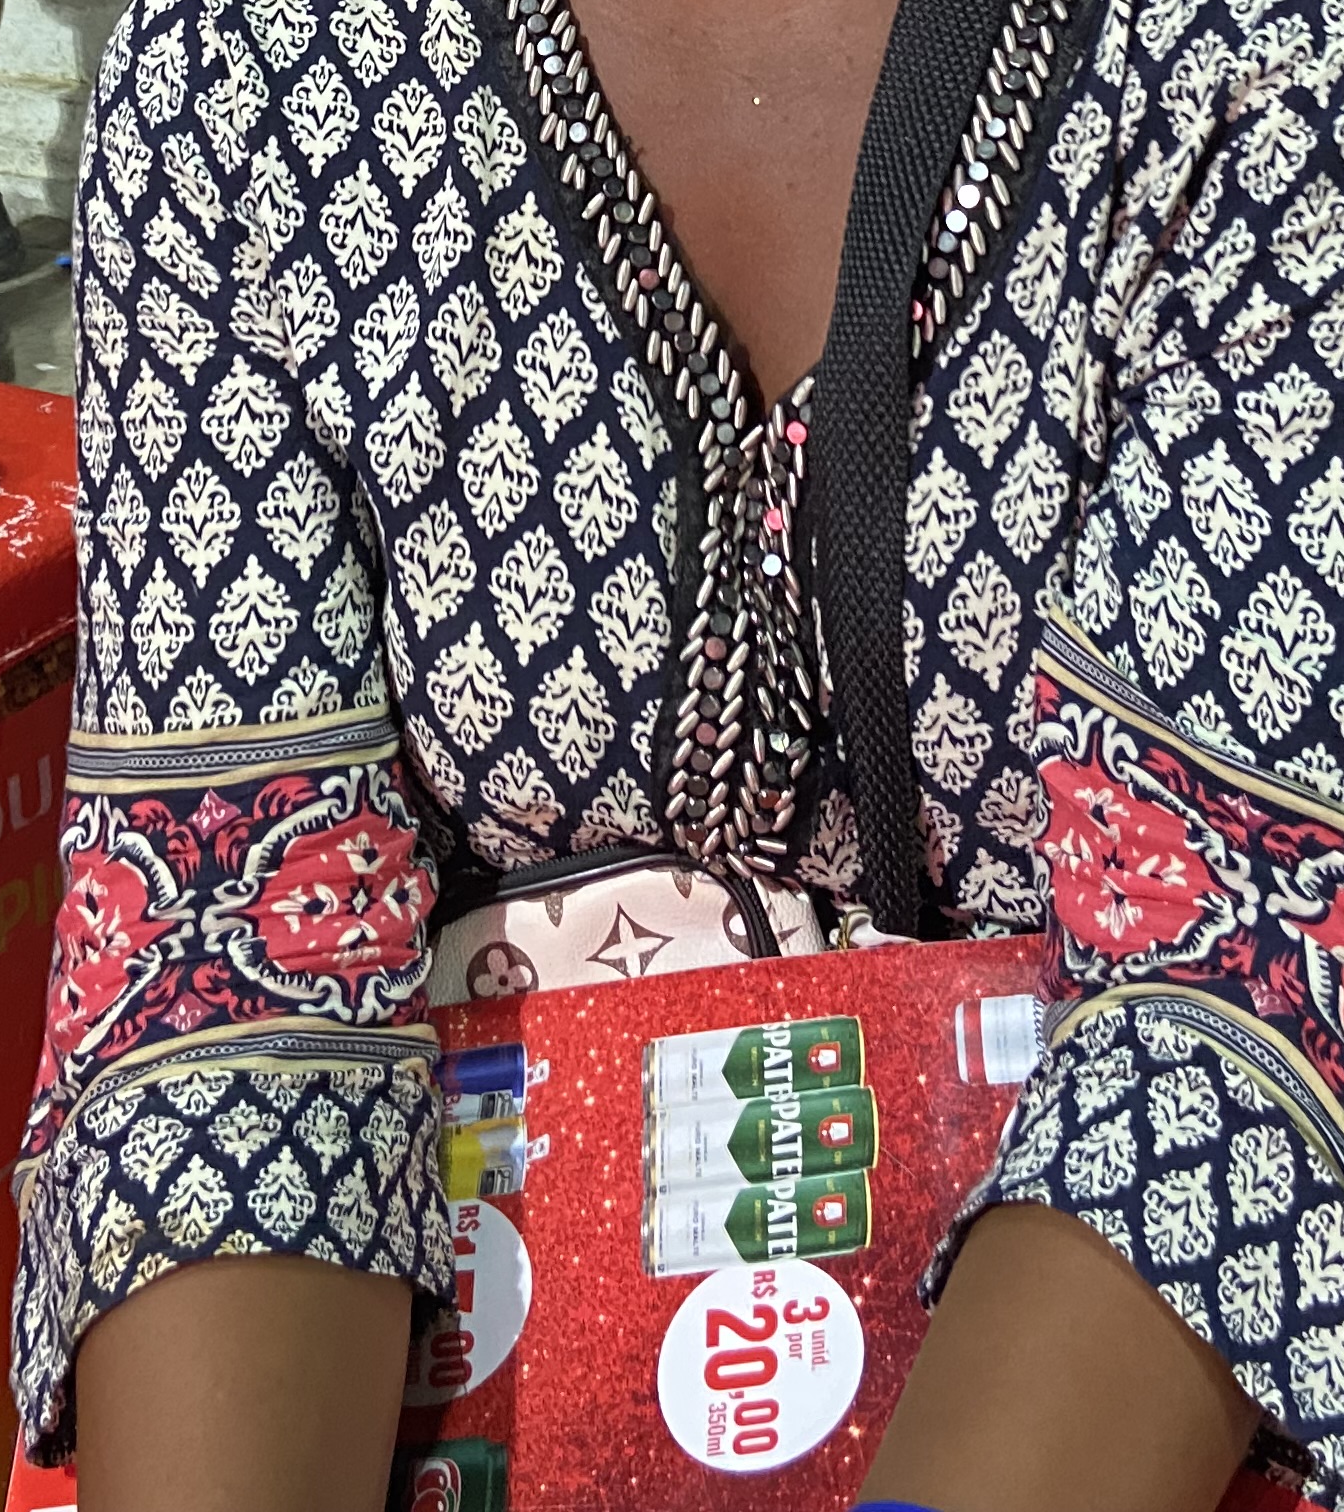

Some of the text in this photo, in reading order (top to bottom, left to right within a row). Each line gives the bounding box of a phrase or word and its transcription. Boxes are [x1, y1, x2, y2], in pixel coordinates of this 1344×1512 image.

[455, 1204, 482, 1234] R$
[782, 1295, 831, 1372] 3 unid.
[785, 1332, 804, 1361] por
[703, 1269, 780, 1456] R$ 20,00
[706, 1401, 726, 1458] 350ml
